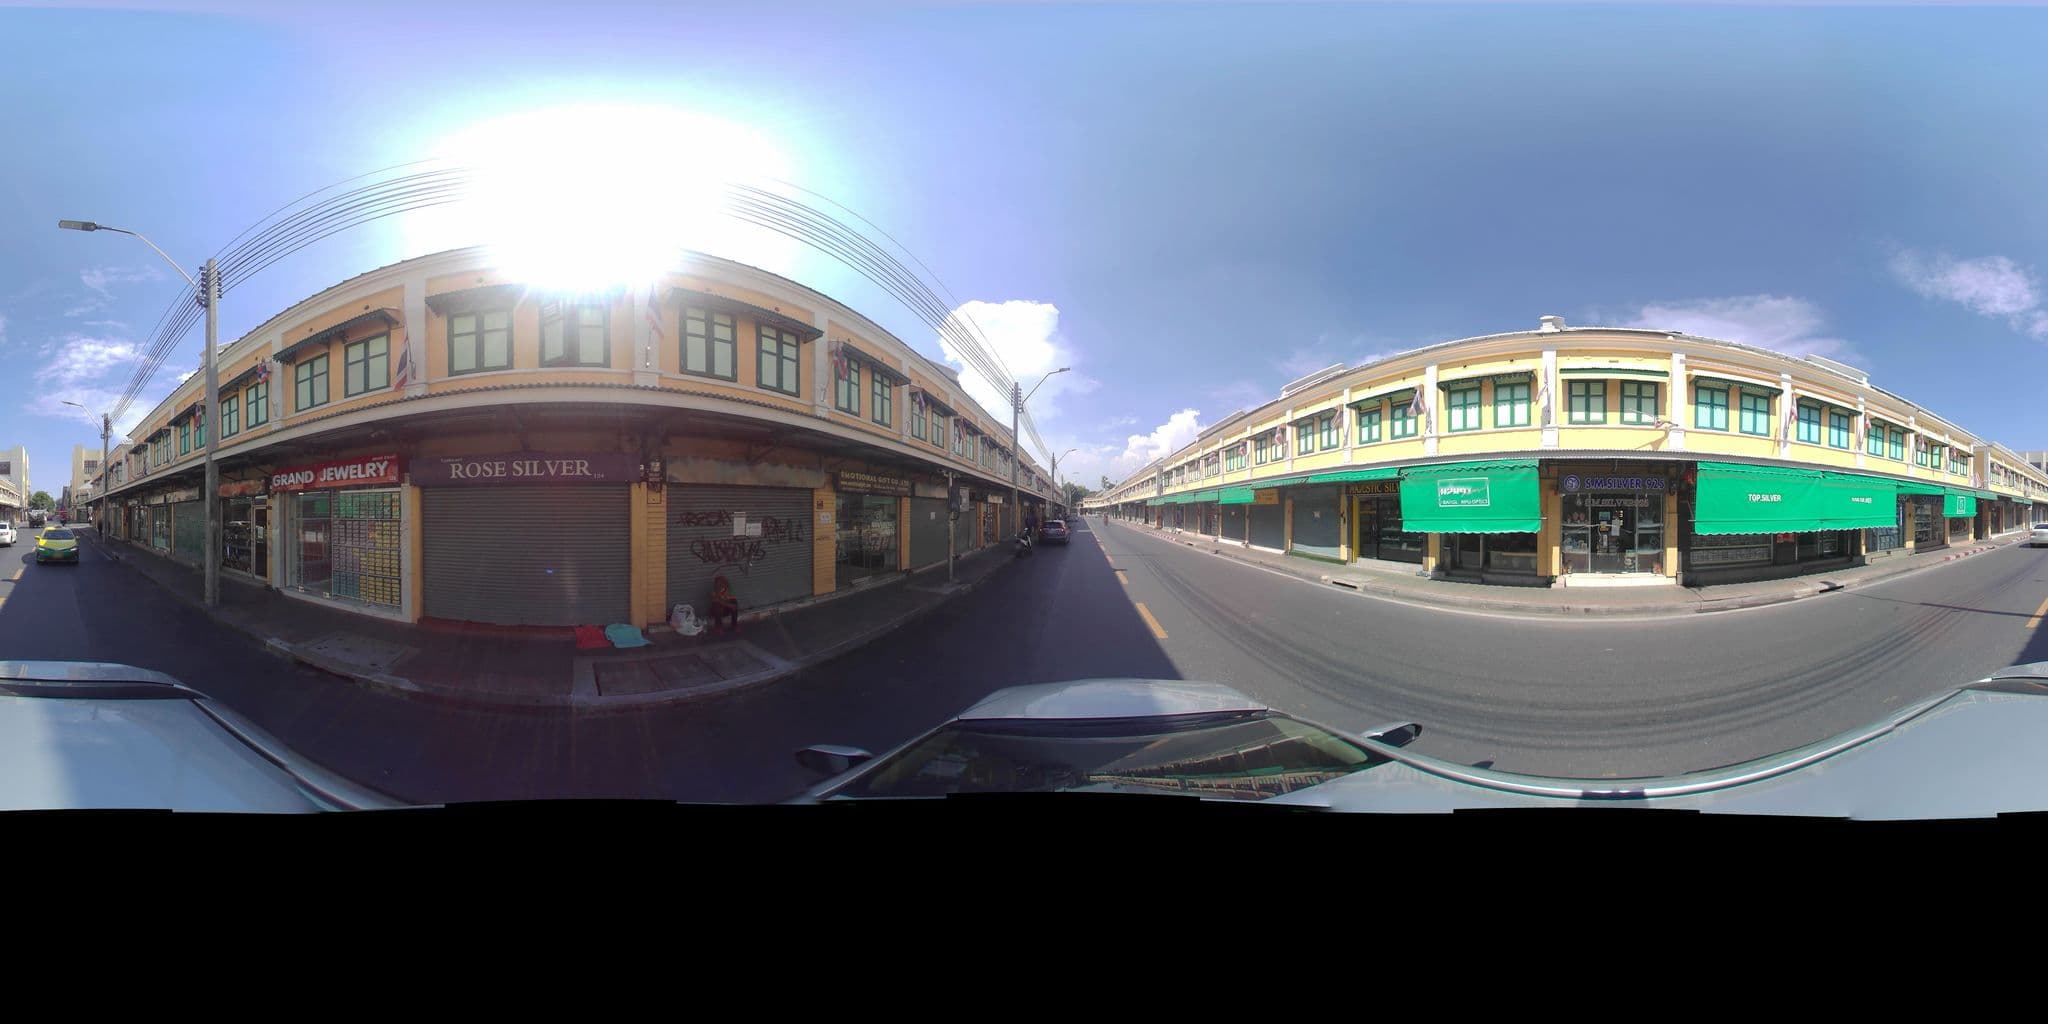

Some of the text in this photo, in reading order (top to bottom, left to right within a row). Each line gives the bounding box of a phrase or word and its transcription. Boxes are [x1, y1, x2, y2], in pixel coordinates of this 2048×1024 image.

[272, 460, 389, 486] GRAND JEWELRY
[450, 459, 593, 479] ROSE SILVER
[1645, 477, 1665, 489] 925
